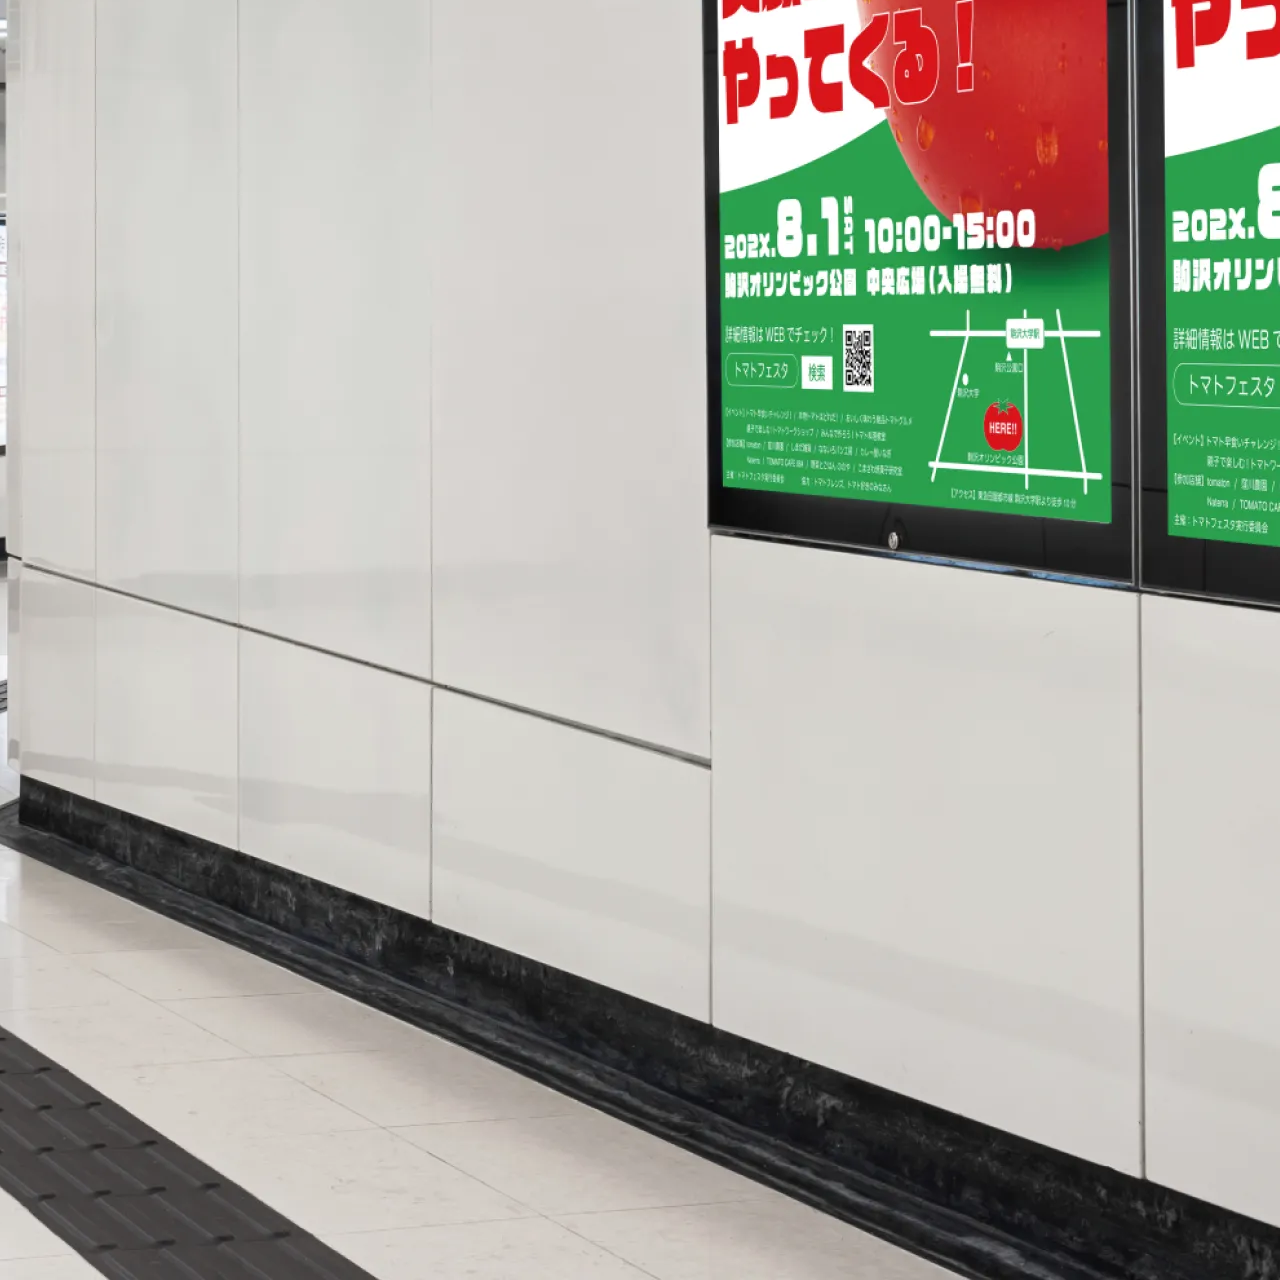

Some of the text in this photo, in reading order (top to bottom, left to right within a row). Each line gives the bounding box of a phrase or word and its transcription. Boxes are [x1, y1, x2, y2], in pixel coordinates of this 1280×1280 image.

[864, 208, 1036, 254] 10:00-15:00
[735, 362, 788, 379] トマトフェスタ
[808, 363, 825, 382] 検索
[1190, 374, 1275, 397] トマトフェスタ
[989, 421, 1017, 435] HERE!!
